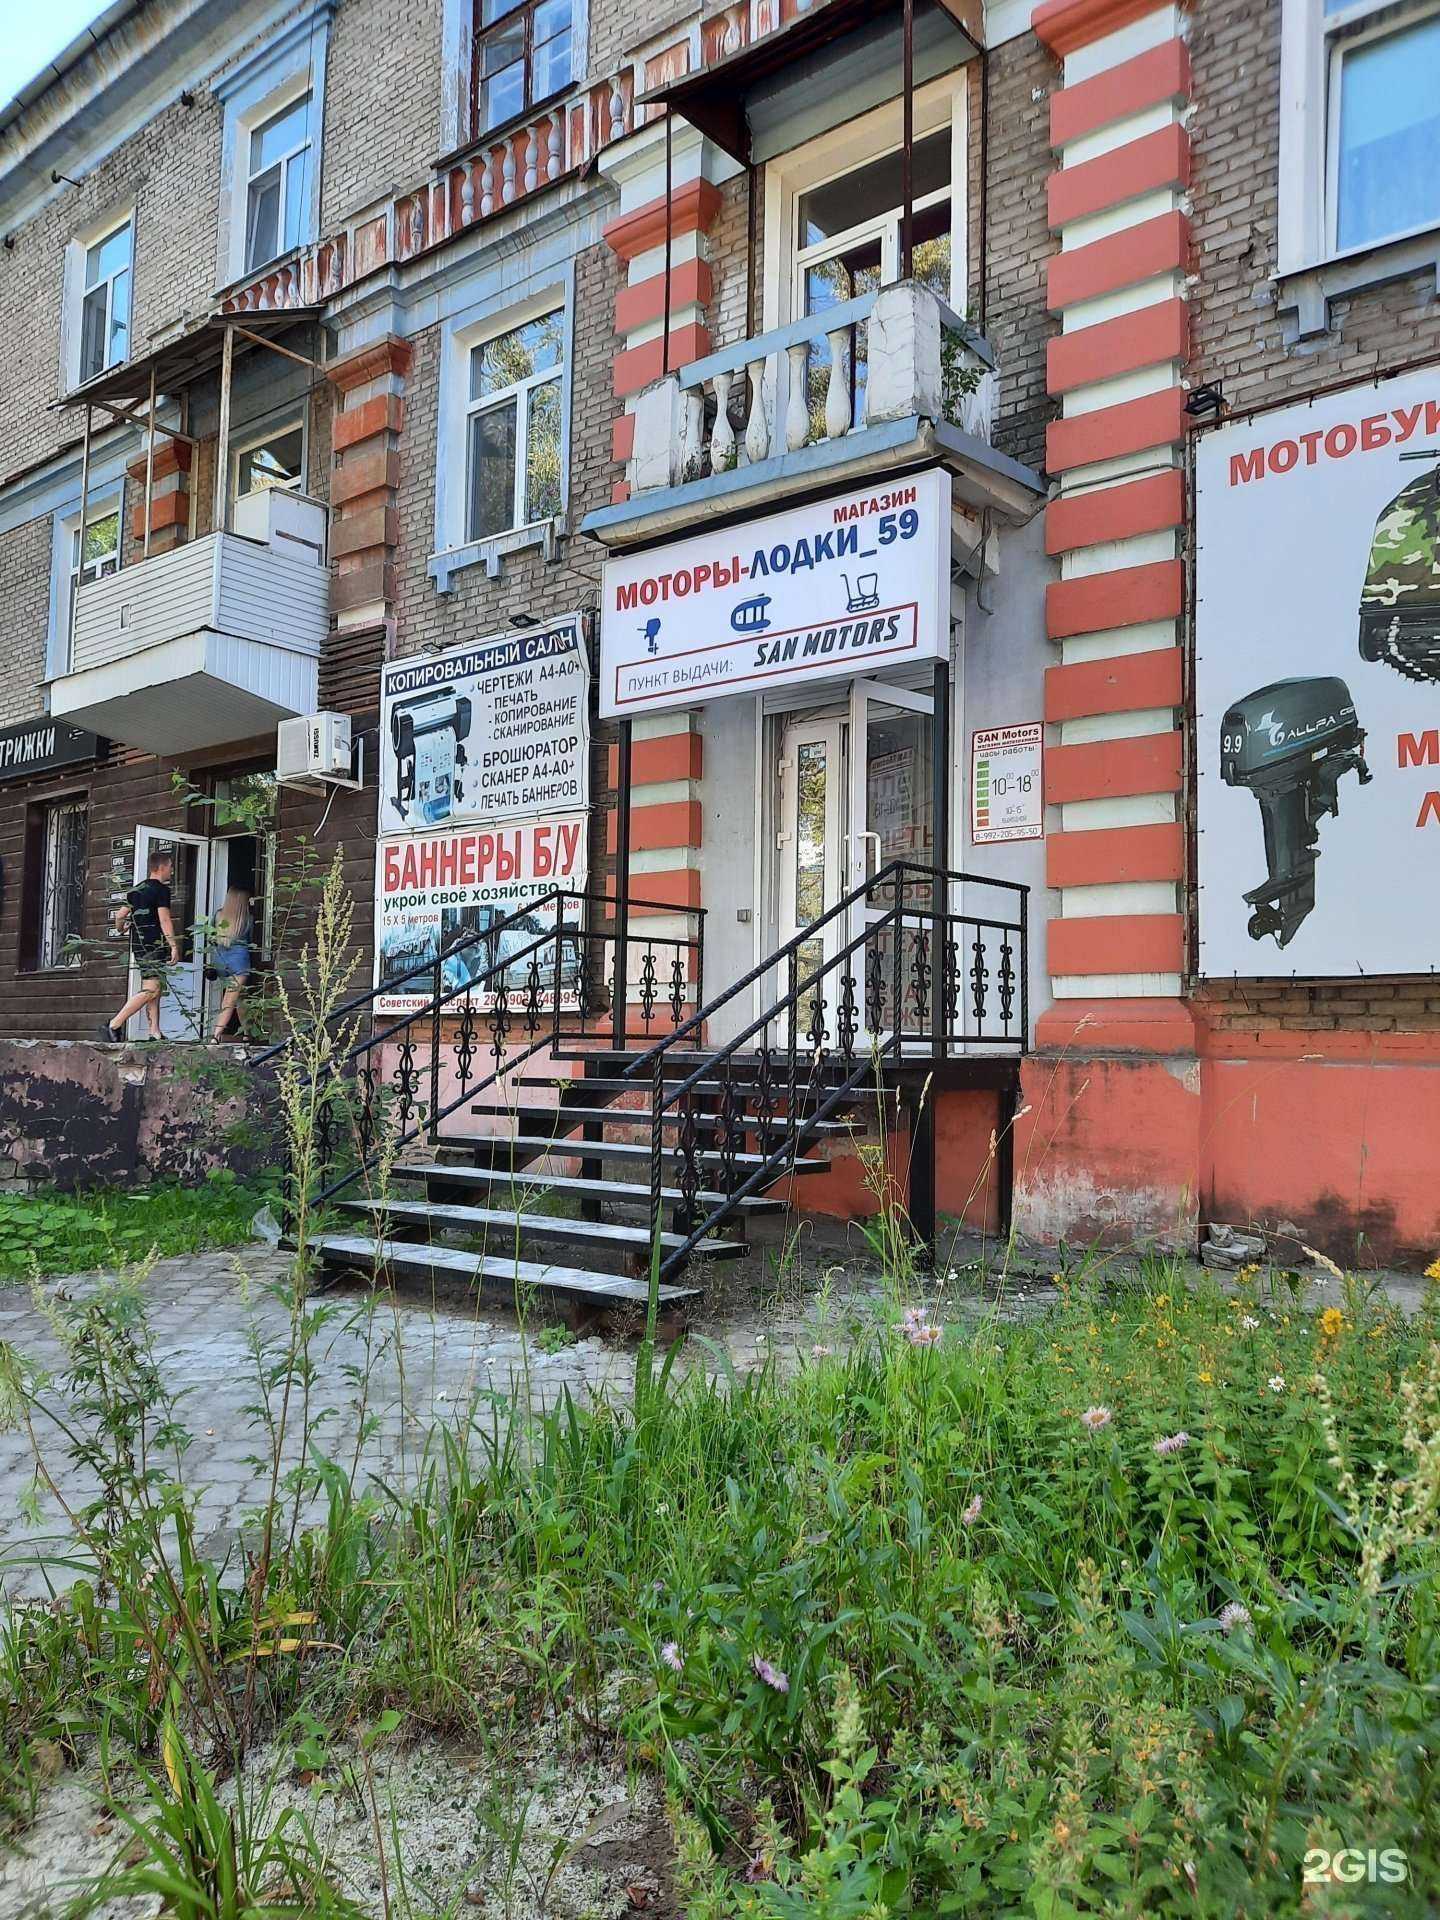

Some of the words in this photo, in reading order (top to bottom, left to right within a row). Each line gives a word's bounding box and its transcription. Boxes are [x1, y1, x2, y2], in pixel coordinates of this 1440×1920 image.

[833, 486, 917, 524] МАГАЗИН
[615, 508, 920, 612] МОТОРЫ-ЛОДКИ_59
[753, 636, 799, 668] SAN
[802, 614, 901, 657] MOTORS
[388, 640, 521, 693] КОПИРОВАЛЬНЫЙ
[628, 670, 670, 693] ПУНКТ
[672, 659, 734, 684] ВЫДАЧИ:
[477, 669, 534, 695] ЧЕРТЕЖИ
[494, 690, 538, 710] ПЕЧАТЬ
[494, 696, 577, 725] КОПИРОВАНИЕ
[493, 712, 575, 741] СКАНИРОВАНИЕ
[977, 732, 999, 744] SAN
[1002, 728, 1039, 740] Motors
[483, 736, 579, 768] БРОШЮРАТОР
[980, 750, 1000, 758] часы
[1223, 734, 1243, 754] 9.9
[481, 767, 529, 788] СКАНЕР
[481, 793, 519, 810] ПЕЧАТЬ
[522, 780, 578, 804] БАННЕРОВ
[384, 830, 522, 892] БАННЕРЫ
[533, 823, 581, 878] Б/У
[384, 890, 426, 913] укрой
[431, 886, 467, 906] своё
[472, 880, 559, 902] хозяйство
[407, 914, 439, 926] метров
